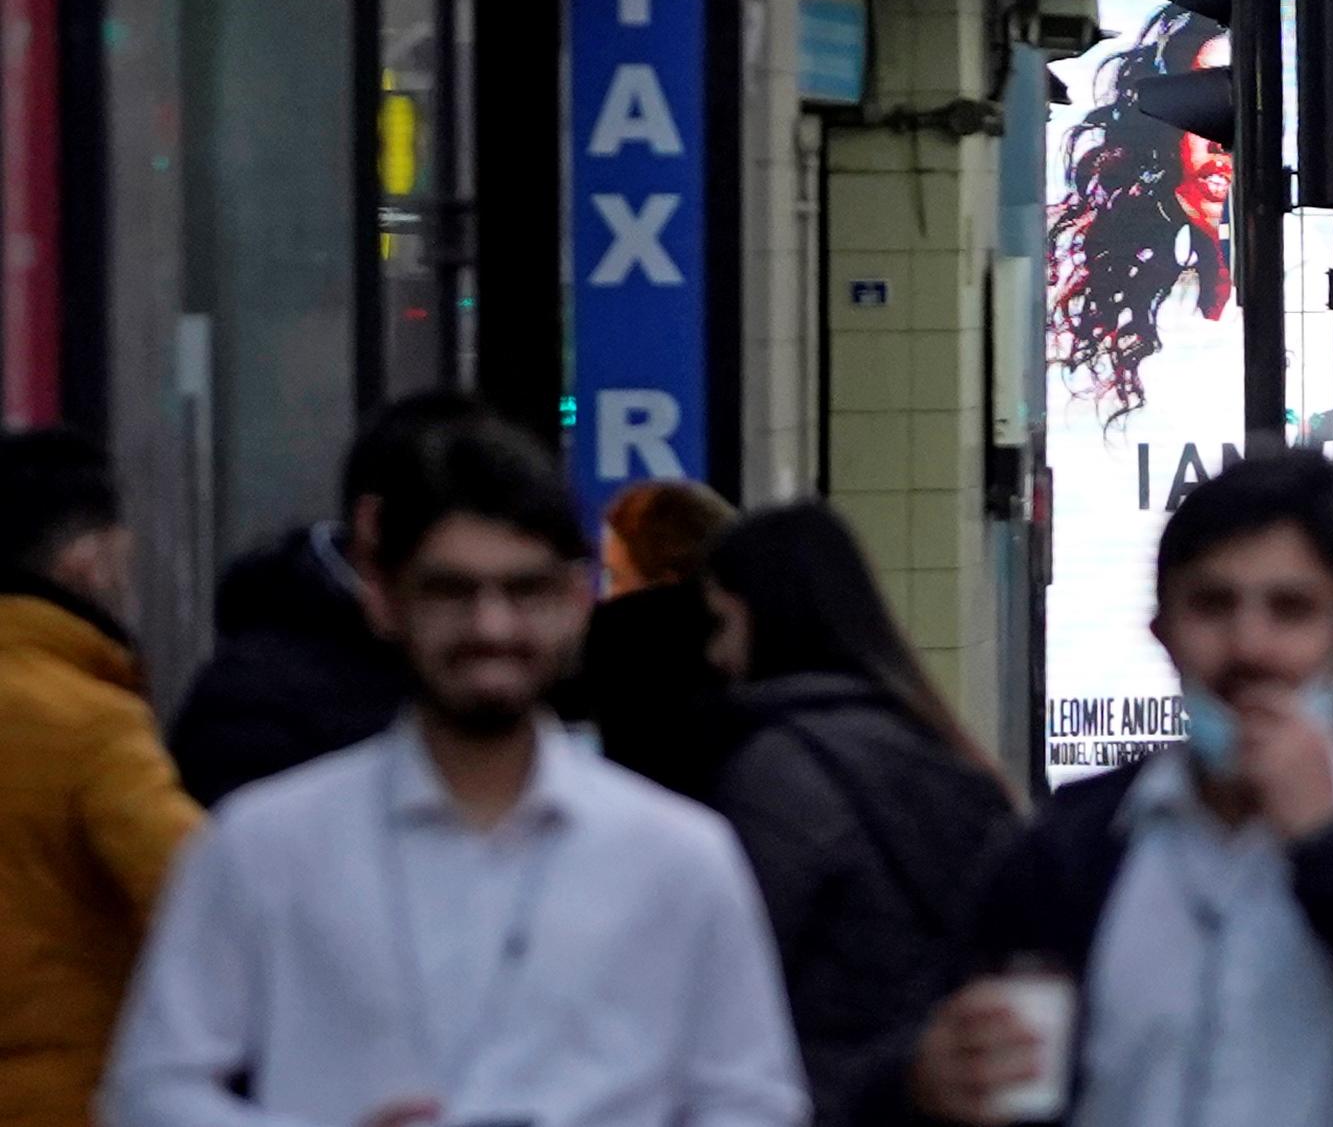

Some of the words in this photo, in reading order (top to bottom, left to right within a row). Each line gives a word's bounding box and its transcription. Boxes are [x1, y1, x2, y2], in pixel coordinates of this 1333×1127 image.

[596, 389, 684, 480] R
[1049, 697, 1116, 738] LEOMIE
[1120, 695, 1192, 737] ANDER
